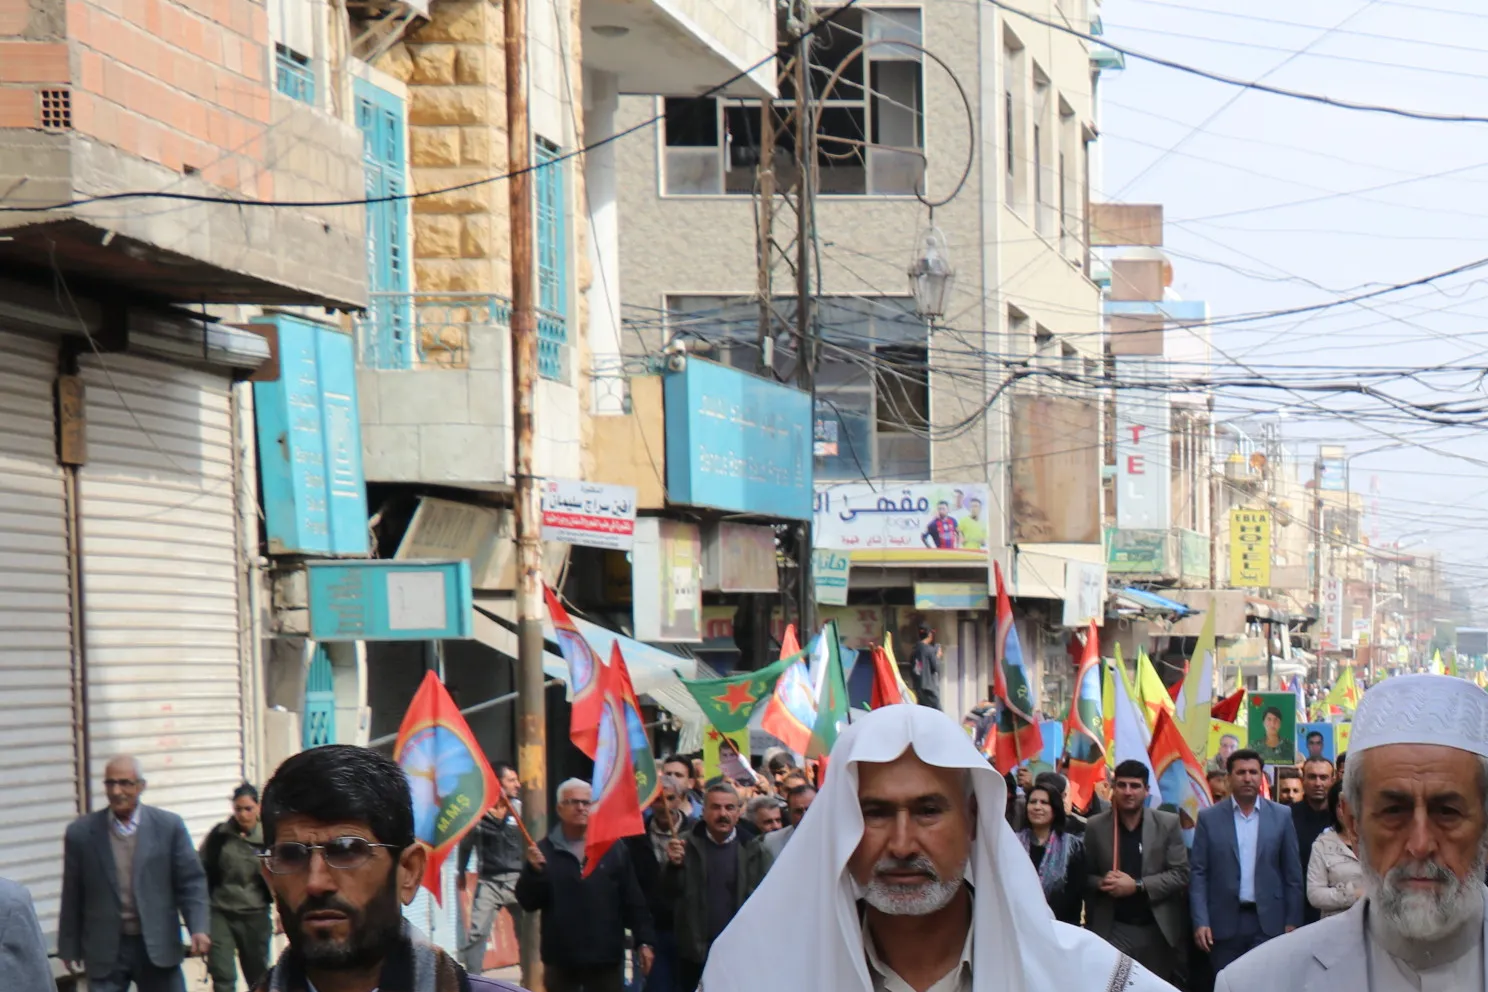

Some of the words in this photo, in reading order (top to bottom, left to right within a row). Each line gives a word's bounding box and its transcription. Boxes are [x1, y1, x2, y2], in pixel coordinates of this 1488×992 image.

[549, 494, 583, 512] سليمان
[583, 499, 609, 515] سراج
[839, 490, 929, 520] مقهى
[1235, 513, 1266, 523] EBLA
[1238, 525, 1262, 570] HOTEL
